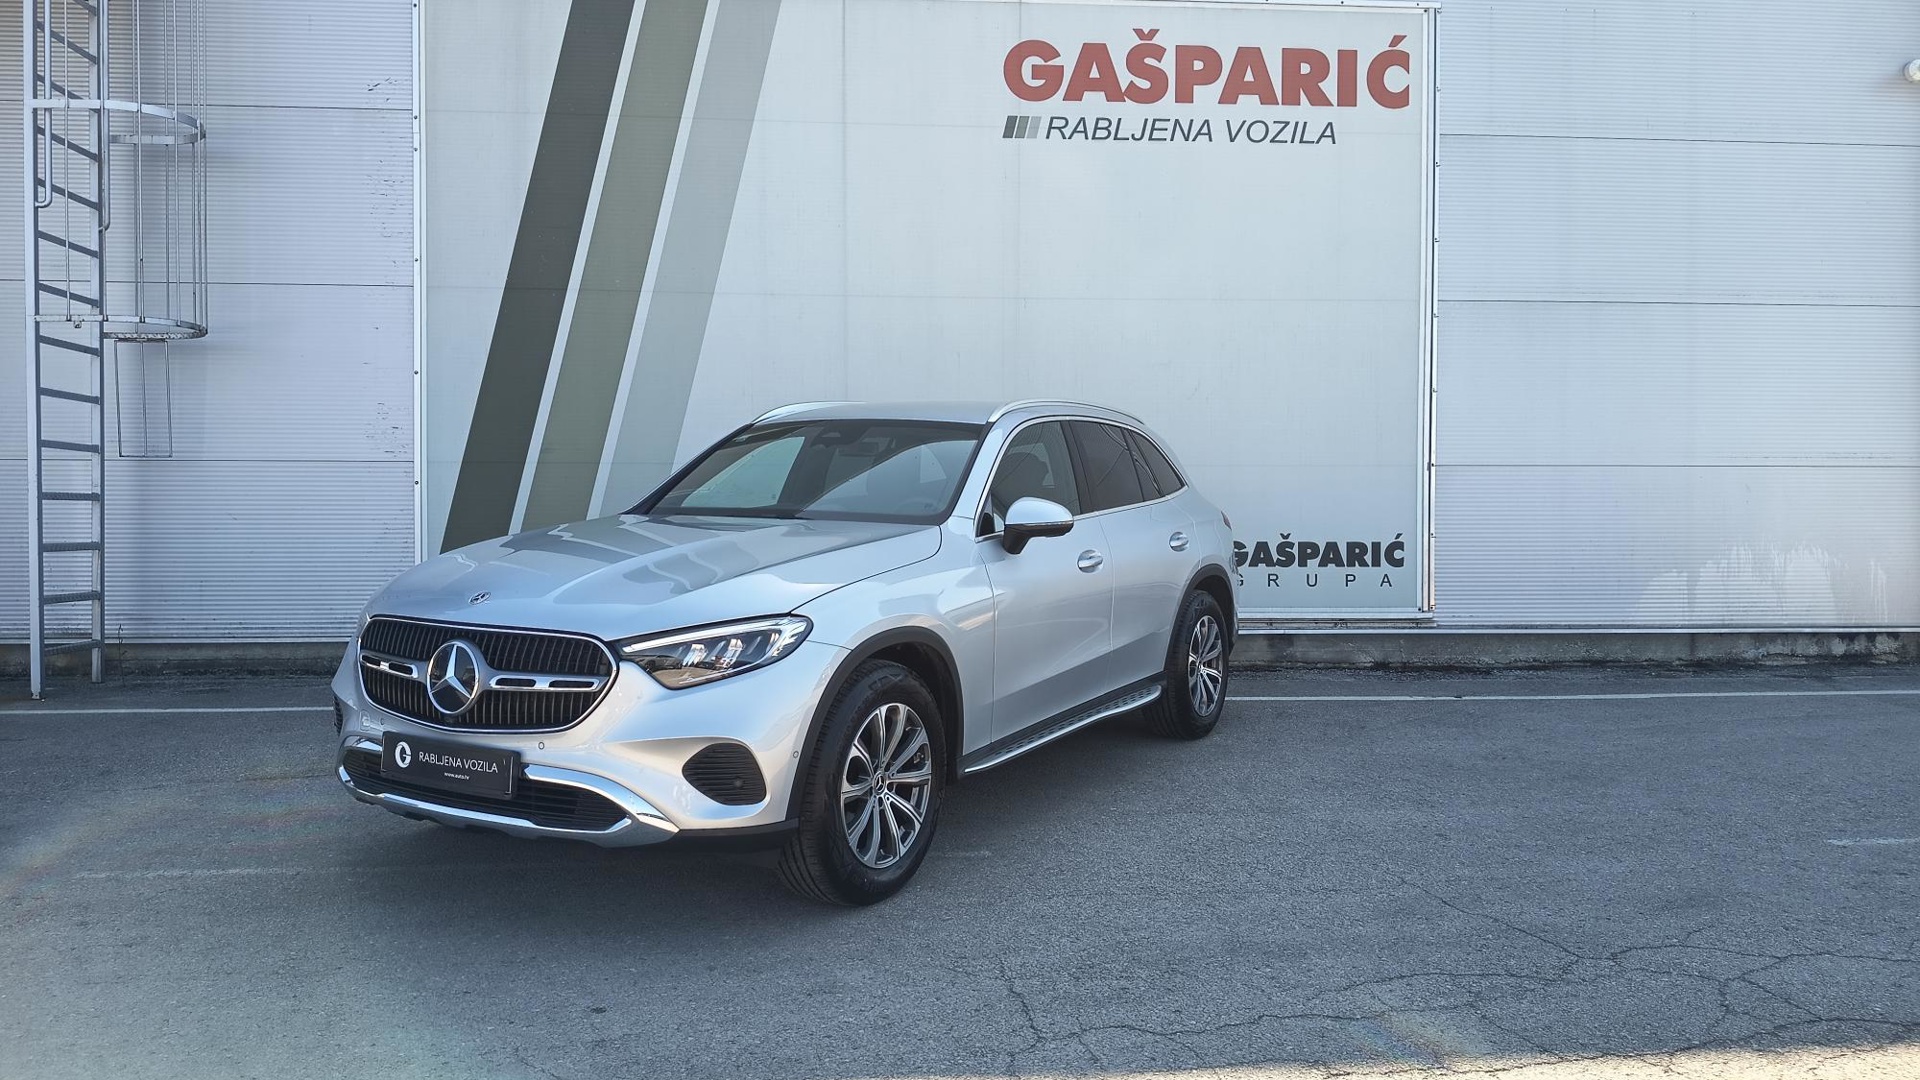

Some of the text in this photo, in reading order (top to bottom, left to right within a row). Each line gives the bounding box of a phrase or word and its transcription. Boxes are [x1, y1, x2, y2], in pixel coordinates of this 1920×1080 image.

[1003, 28, 1410, 109] GAŠPARIĆ
[1045, 116, 1337, 145] RABLJENA VOZILA
[418, 751, 499, 773] RABLJENA VOZILA
